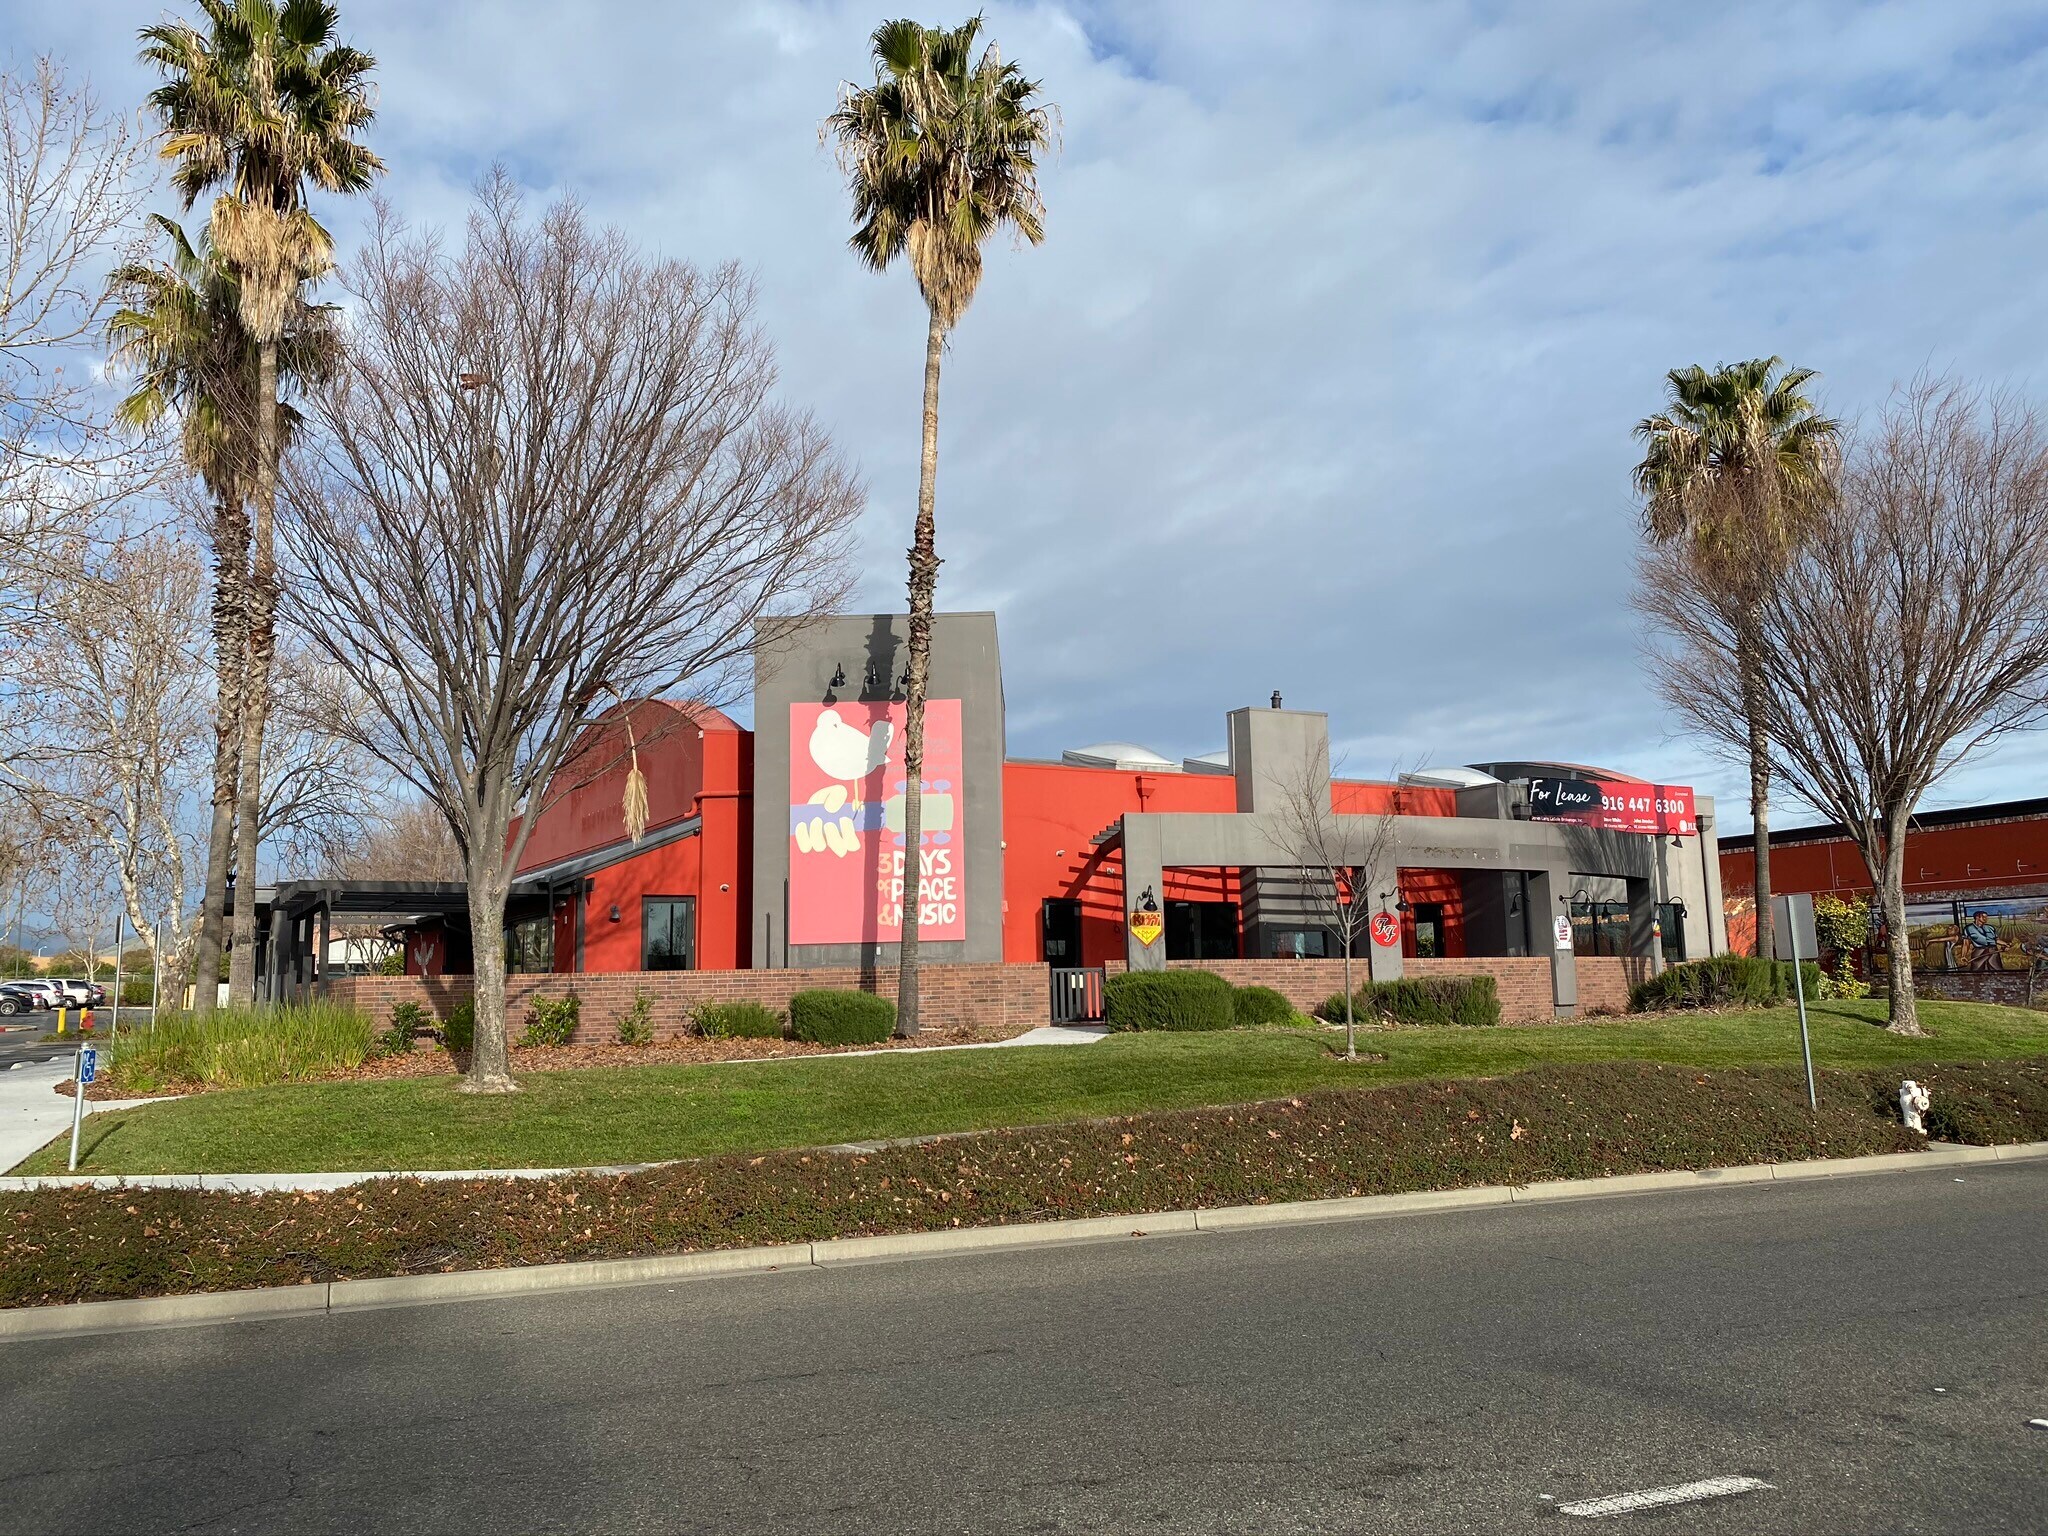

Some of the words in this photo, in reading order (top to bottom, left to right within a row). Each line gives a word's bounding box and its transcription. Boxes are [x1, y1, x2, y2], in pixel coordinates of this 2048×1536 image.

[1530, 779, 1551, 802] For
[1555, 782, 1591, 806] Lease
[1601, 795, 1624, 811] 916
[1628, 797, 1650, 812] 447
[1655, 798, 1684, 814] 6300
[878, 852, 893, 874] 3
[891, 876, 957, 902] PACE
[877, 903, 894, 927] &
